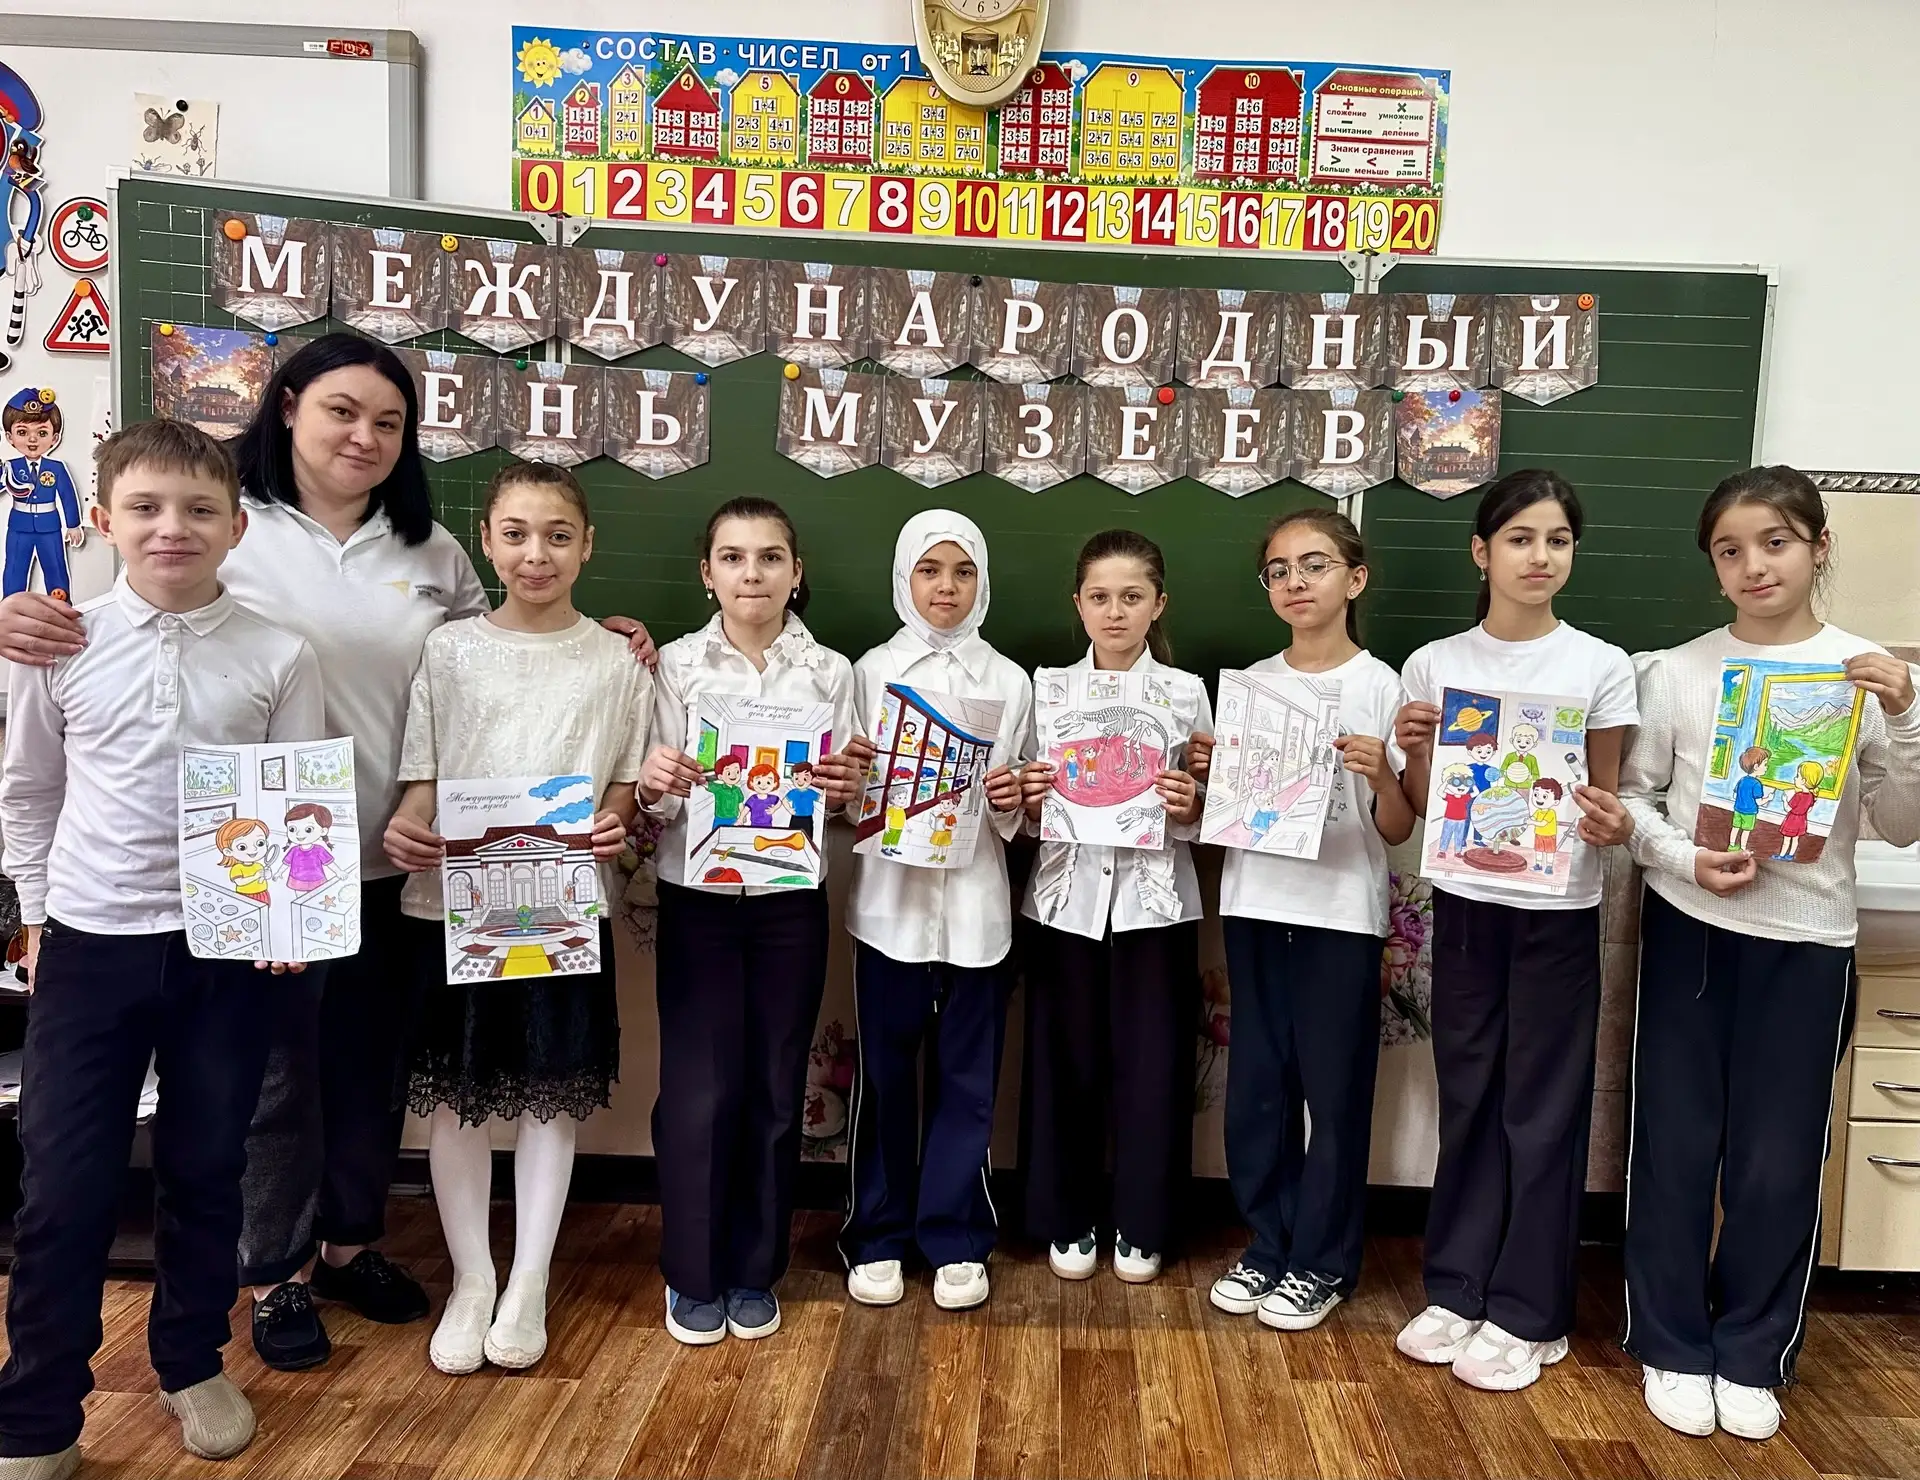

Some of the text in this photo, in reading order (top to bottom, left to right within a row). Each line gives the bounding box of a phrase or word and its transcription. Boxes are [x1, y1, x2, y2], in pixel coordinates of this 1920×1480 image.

[978, 0, 984, 14] 6
[595, 37, 911, 72] СОСТАВ ЧИСЕЛ от 1
[624, 73, 631, 85] 3
[683, 76, 690, 88] 4
[762, 77, 768, 89] 5
[1035, 72, 1042, 82] 8
[1130, 74, 1137, 85] 9
[1247, 75, 1258, 87] 10
[839, 79, 846, 91] 6
[1330, 83, 1424, 96] Основные операции
[578, 91, 586, 102] 2
[931, 86, 937, 97] 7
[533, 107, 538, 117] 1
[1327, 109, 1367, 117] сложение
[1325, 127, 1372, 135] вычитание
[1331, 144, 1414, 156] Знаки сравнения
[1320, 165, 1350, 173] больше
[527, 164, 1435, 250] 0 1 2 3 4 5 6 7 8 9 10 11 12 13 14 15 16 17 18 19 20
[238, 235, 1571, 382] МЕЖДУНАРОДНЫЙ
[420, 371, 1366, 464] ЕНЬ МУЗЕЕВ
[446, 792, 521, 804] Международный
[459, 802, 508, 813] день музеев
